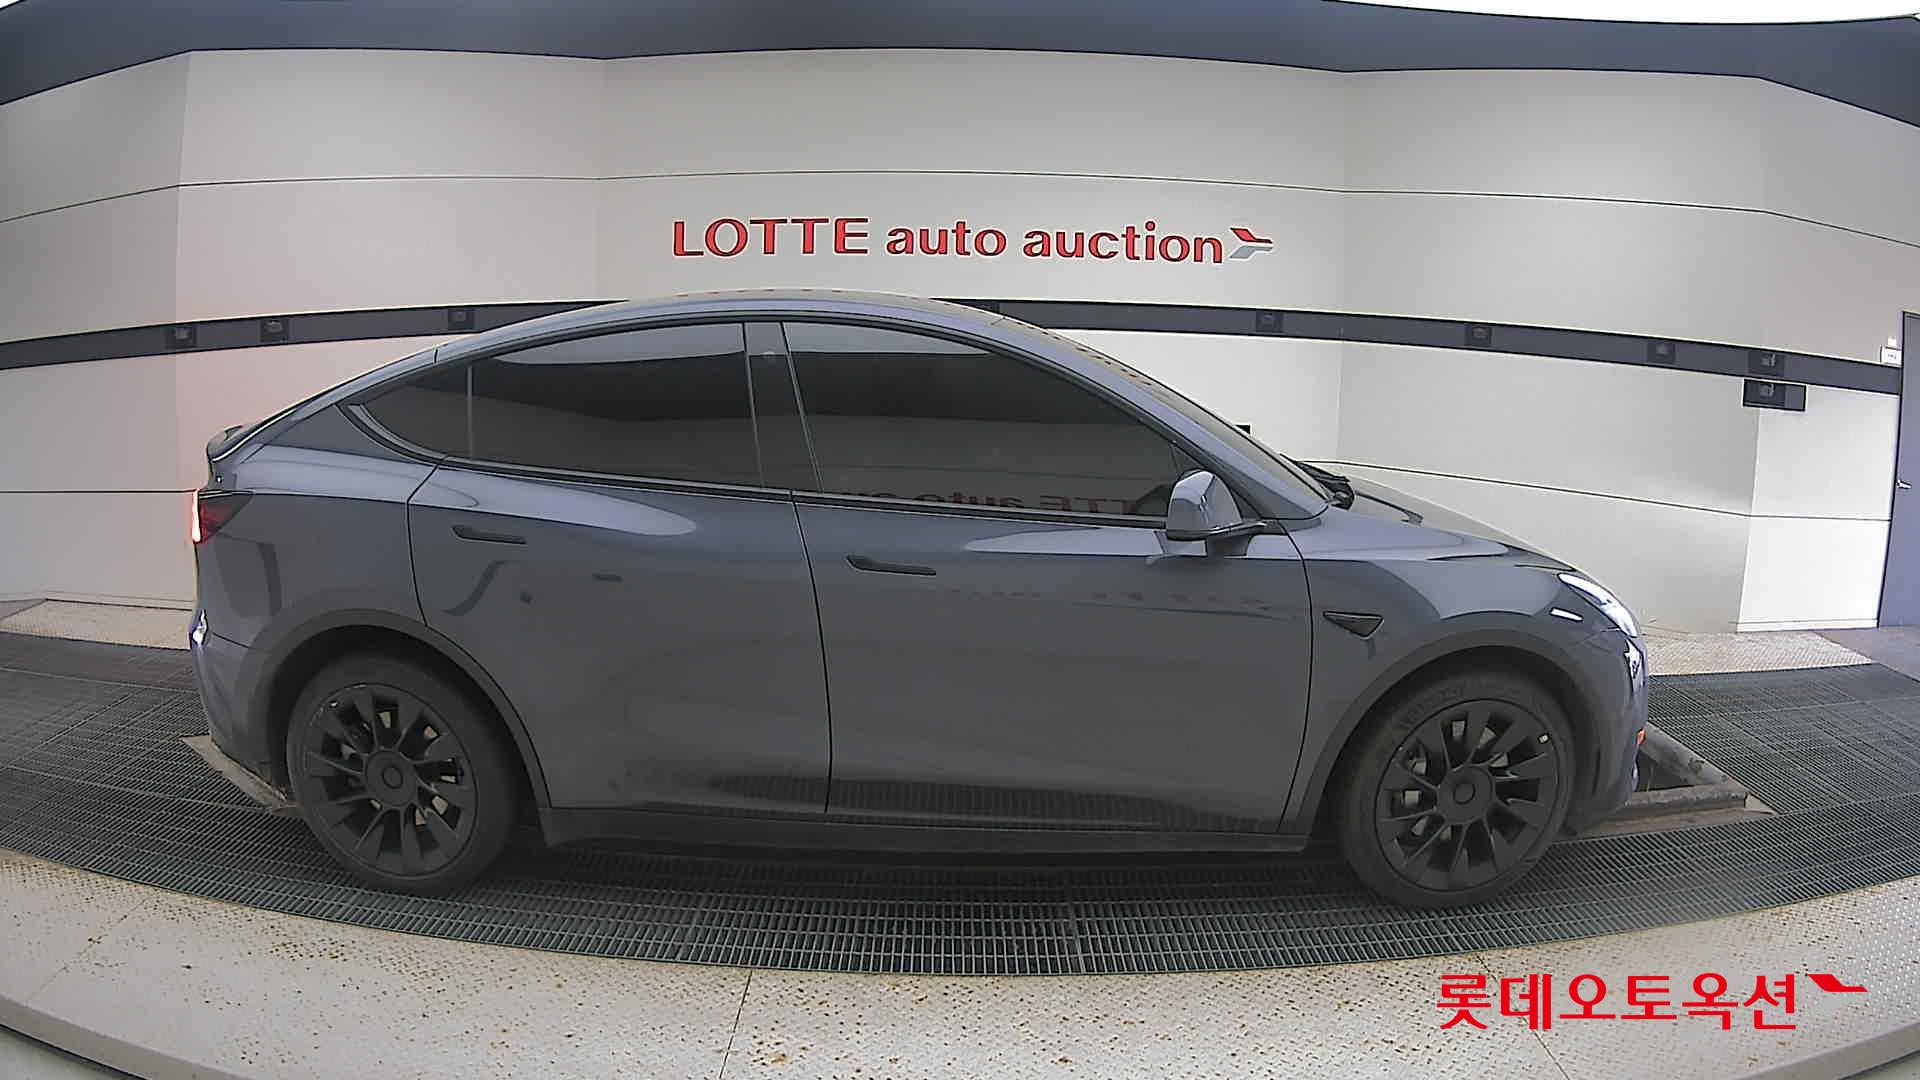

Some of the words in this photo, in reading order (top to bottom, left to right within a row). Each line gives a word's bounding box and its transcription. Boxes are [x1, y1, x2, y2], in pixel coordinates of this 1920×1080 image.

[673, 217, 869, 257] LOTTE
[886, 221, 1008, 257] auto
[1023, 221, 1223, 264] auction
